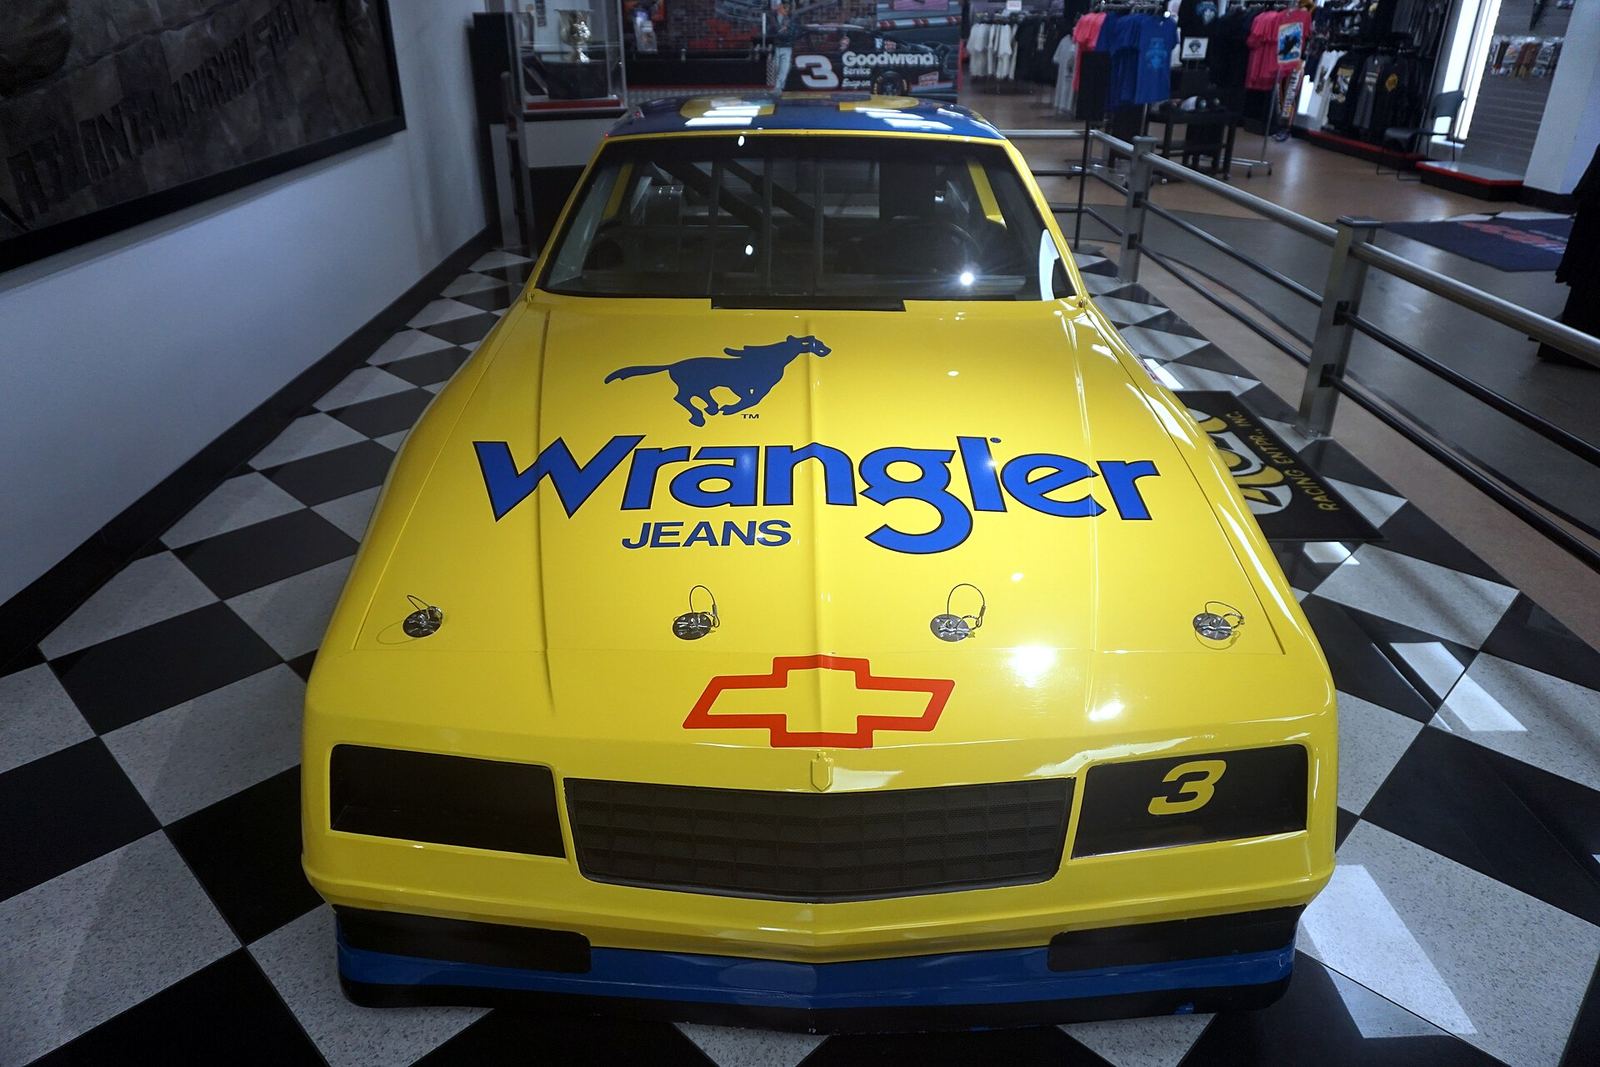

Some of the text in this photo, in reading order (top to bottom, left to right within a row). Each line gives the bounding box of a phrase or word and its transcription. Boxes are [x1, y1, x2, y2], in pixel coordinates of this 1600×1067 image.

[795, 54, 839, 89] 3
[472, 434, 1161, 555] Wrangler
[1284, 468, 1341, 512] RACING
[621, 519, 793, 550] JEANS
[1148, 759, 1228, 816] 3
